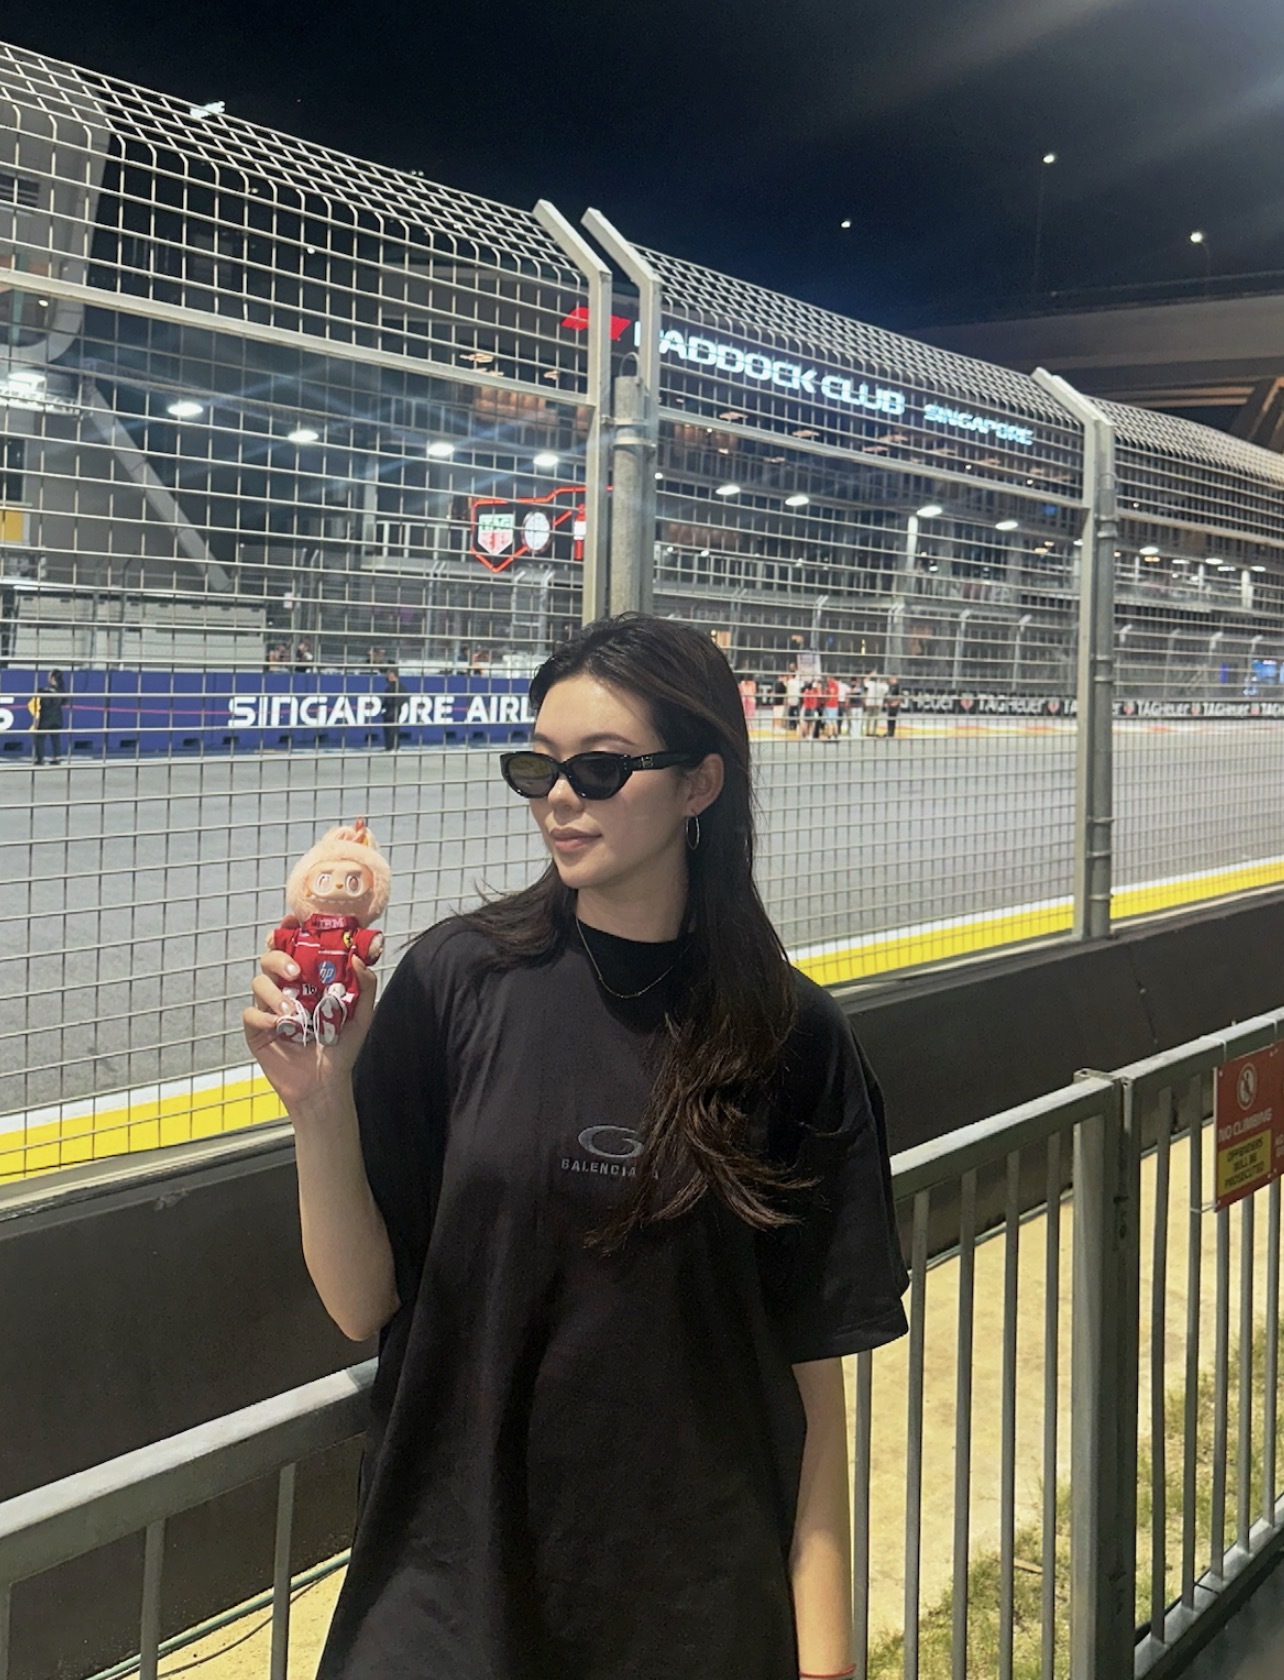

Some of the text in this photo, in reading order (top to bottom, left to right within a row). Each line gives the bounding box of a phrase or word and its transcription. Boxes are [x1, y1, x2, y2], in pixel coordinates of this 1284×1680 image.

[820, 374, 906, 416] CLUB
[923, 403, 1034, 446] SINGAPORE
[319, 960, 335, 984] hp
[1218, 1126, 1232, 1142] NO
[560, 1158, 659, 1180] BALENCIA
